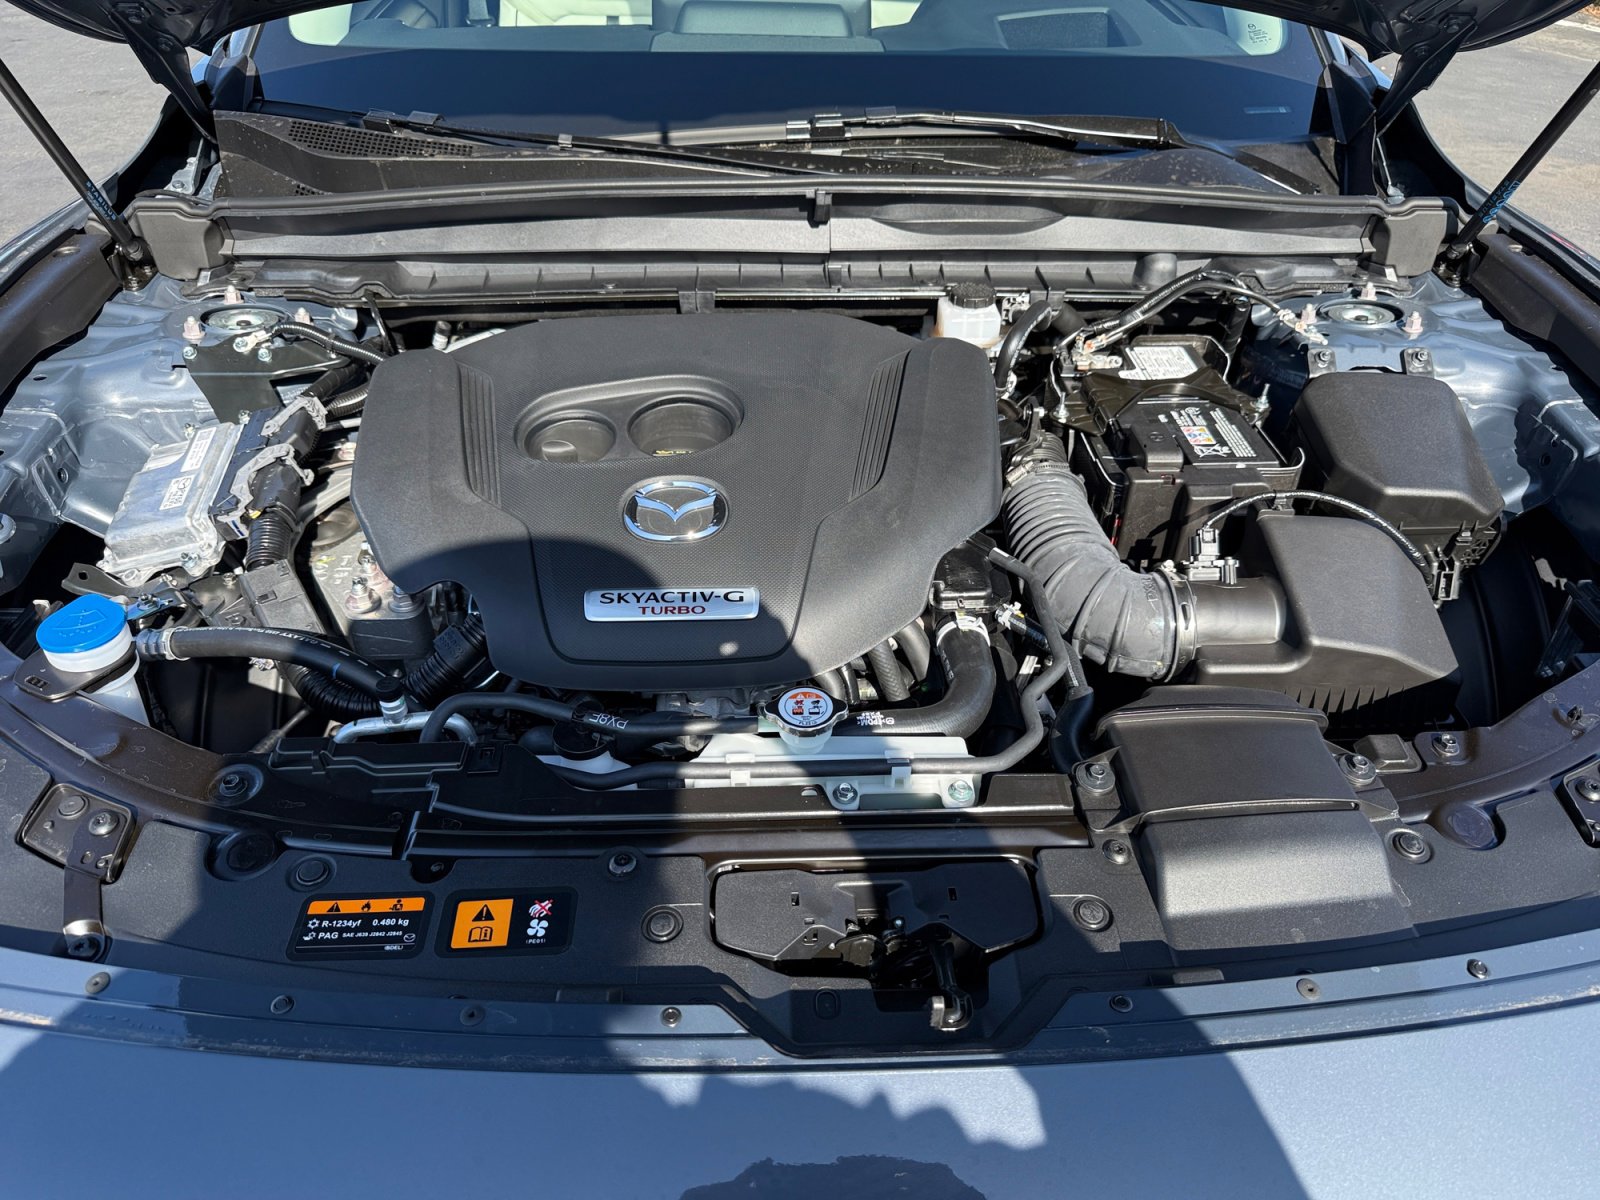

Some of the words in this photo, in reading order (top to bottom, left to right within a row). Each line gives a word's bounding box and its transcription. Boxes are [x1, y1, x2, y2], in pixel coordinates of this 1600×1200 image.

[85, 180, 117, 221] STABILUS
[600, 591, 744, 605] SKYACTIV-G
[638, 606, 706, 616] TURBO
[321, 919, 362, 928] R-1234yf
[372, 918, 396, 927] 0.480
[397, 917, 410, 927] kg
[317, 931, 339, 940] PAG
